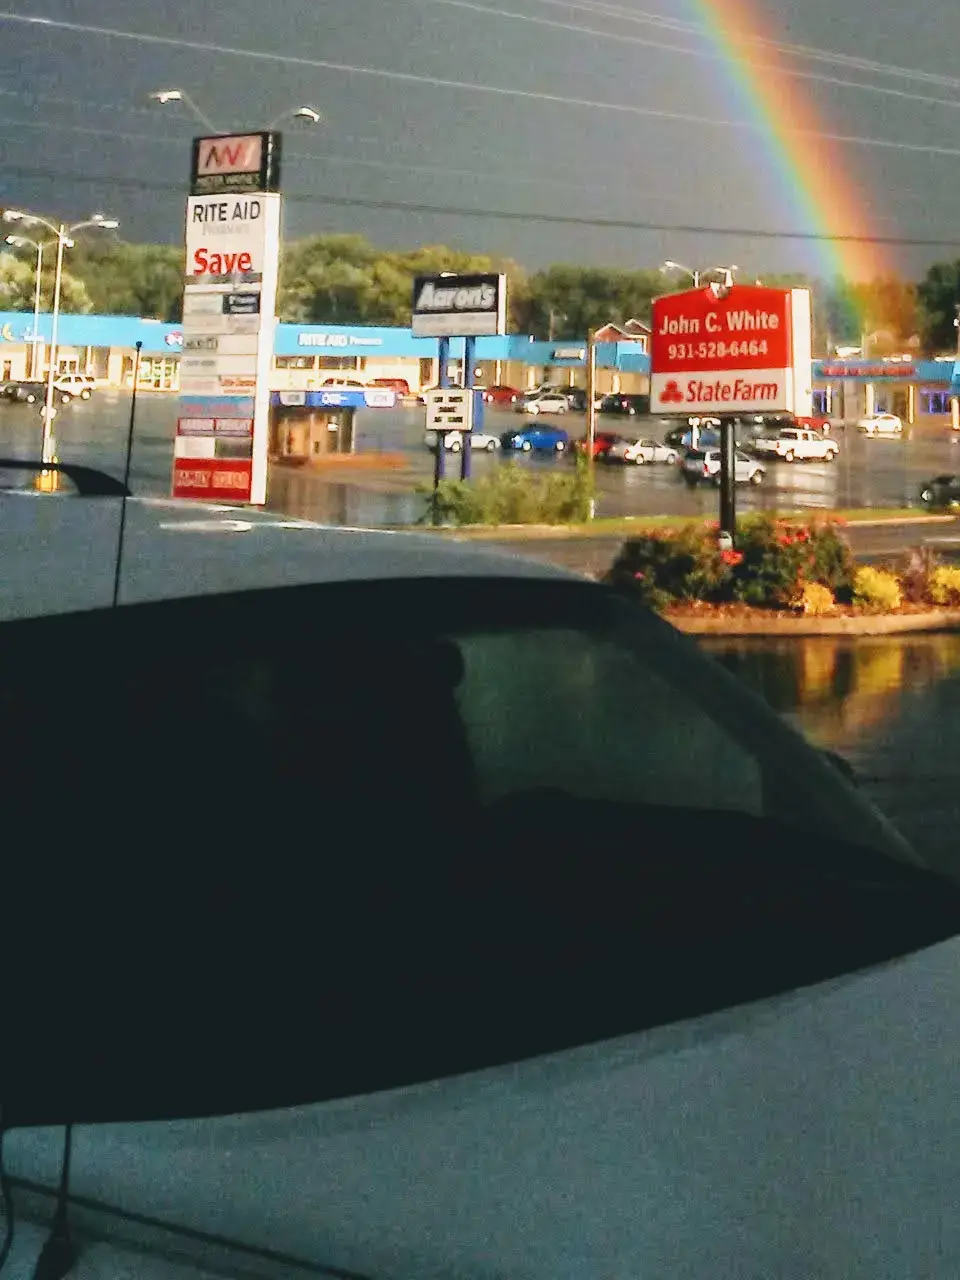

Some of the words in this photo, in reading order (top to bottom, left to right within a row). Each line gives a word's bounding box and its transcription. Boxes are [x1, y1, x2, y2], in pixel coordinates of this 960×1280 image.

[193, 202, 228, 223] RITE
[232, 200, 260, 220] AID
[193, 247, 252, 276] Save
[416, 282, 496, 311] Aaron's
[659, 314, 699, 335] John
[705, 312, 722, 332] C.
[726, 310, 779, 331] White
[668, 340, 768, 360] 931-528-6464
